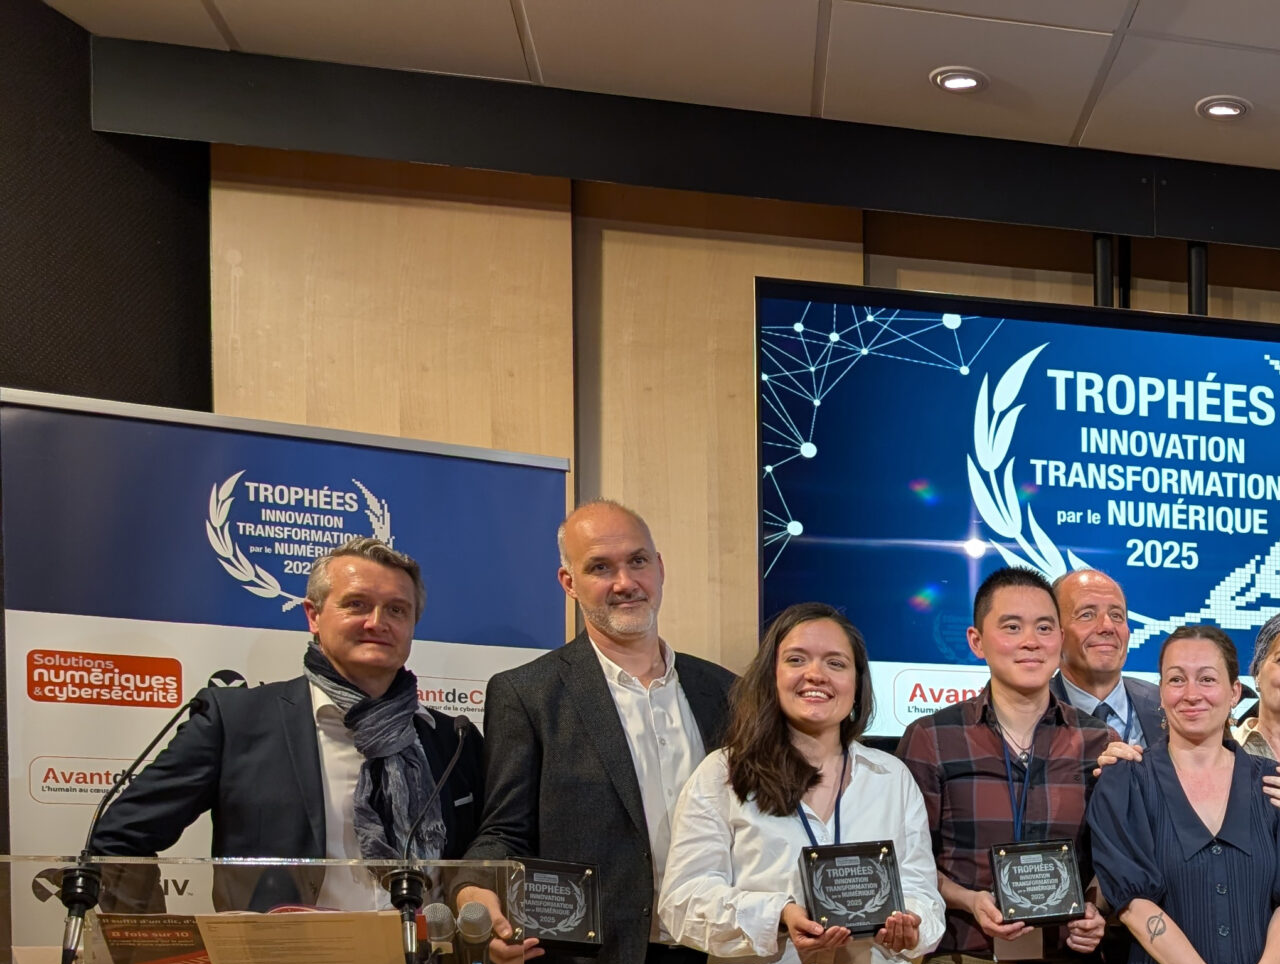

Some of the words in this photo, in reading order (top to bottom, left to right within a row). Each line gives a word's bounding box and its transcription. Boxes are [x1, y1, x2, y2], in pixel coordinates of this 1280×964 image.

[1047, 368, 1276, 427] TROPHÉES
[1081, 427, 1245, 464] INNOVATION
[244, 481, 359, 513] TROPHÉES
[261, 508, 344, 529] INNOVATION
[1057, 509, 1083, 525] par
[1087, 509, 1101, 525] le
[1107, 498, 1269, 535] NUMÉRIQUE
[264, 545, 272, 553] le
[1126, 538, 1199, 570] 2025
[283, 560, 313, 575] 202
[33, 653, 114, 669] Solutions
